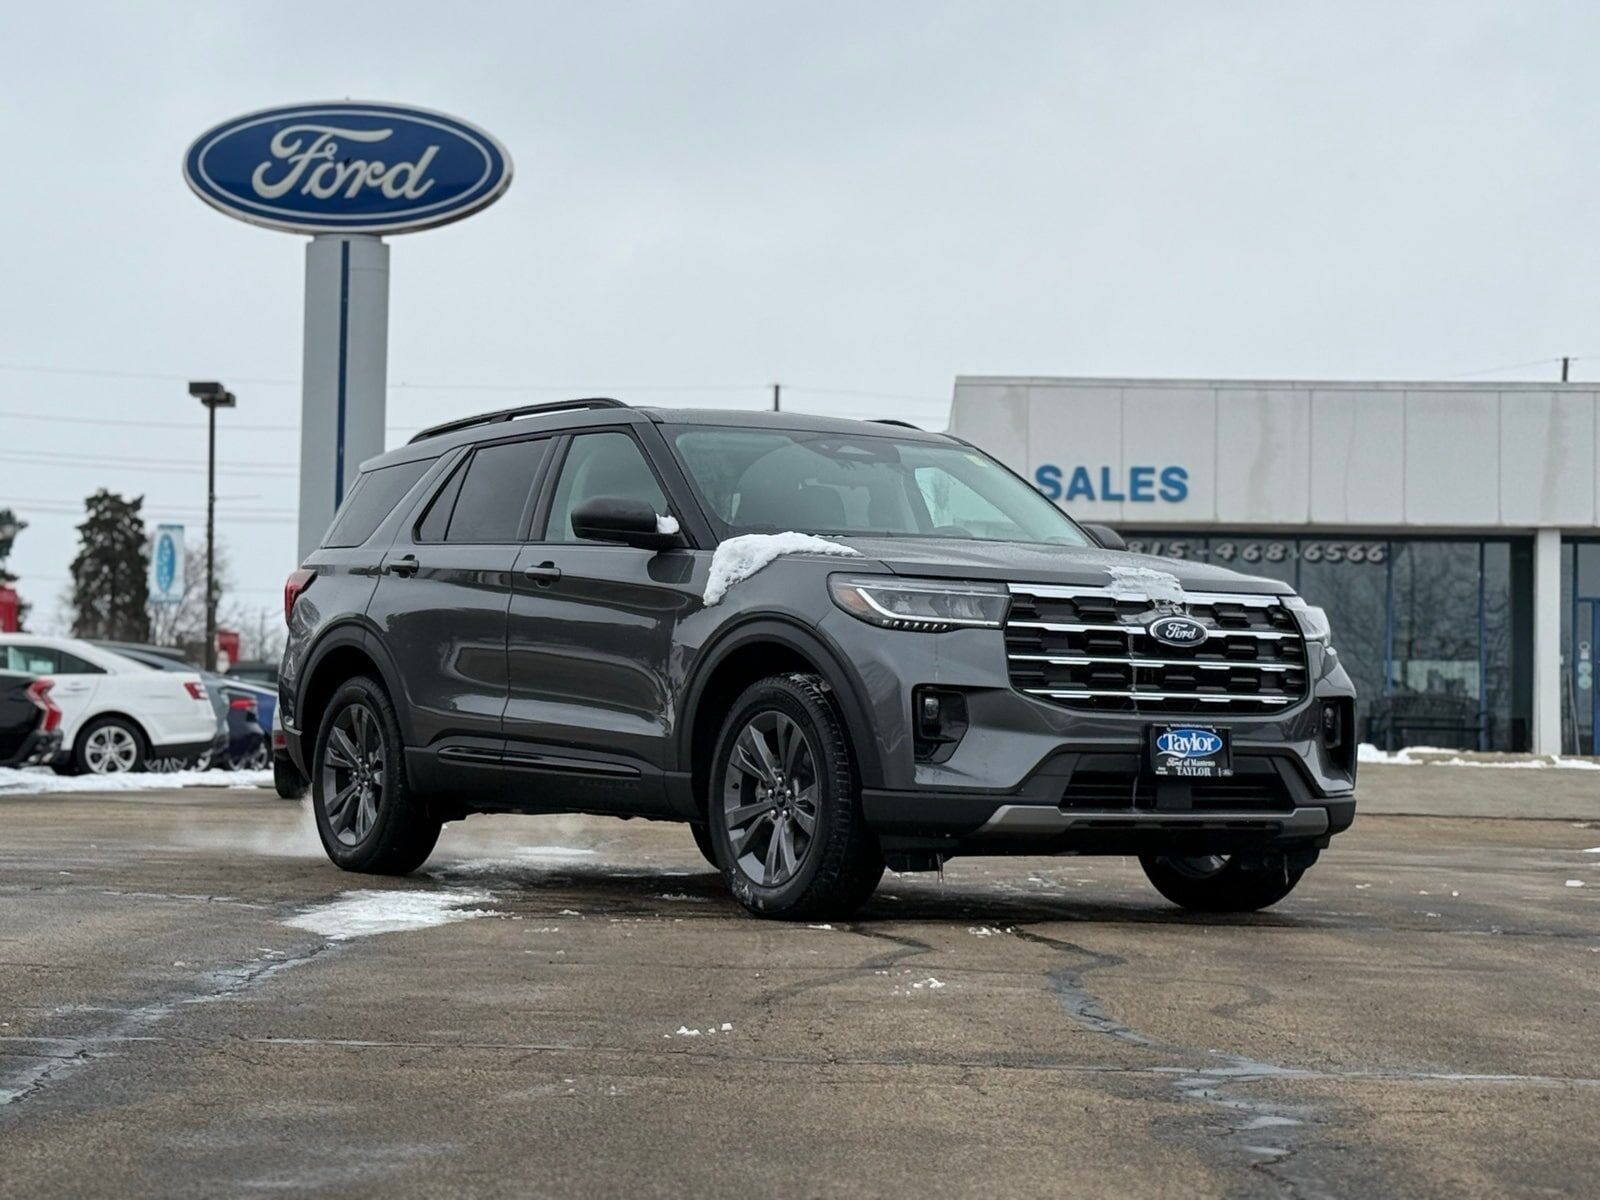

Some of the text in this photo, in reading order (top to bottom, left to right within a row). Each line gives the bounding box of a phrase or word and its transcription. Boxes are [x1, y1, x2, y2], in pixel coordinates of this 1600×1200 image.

[251, 123, 440, 199] Ford
[1035, 464, 1189, 503] SALES
[1165, 622, 1197, 640] Ford
[1157, 732, 1215, 758] Taylor
[1175, 766, 1211, 777] TAYLOR
